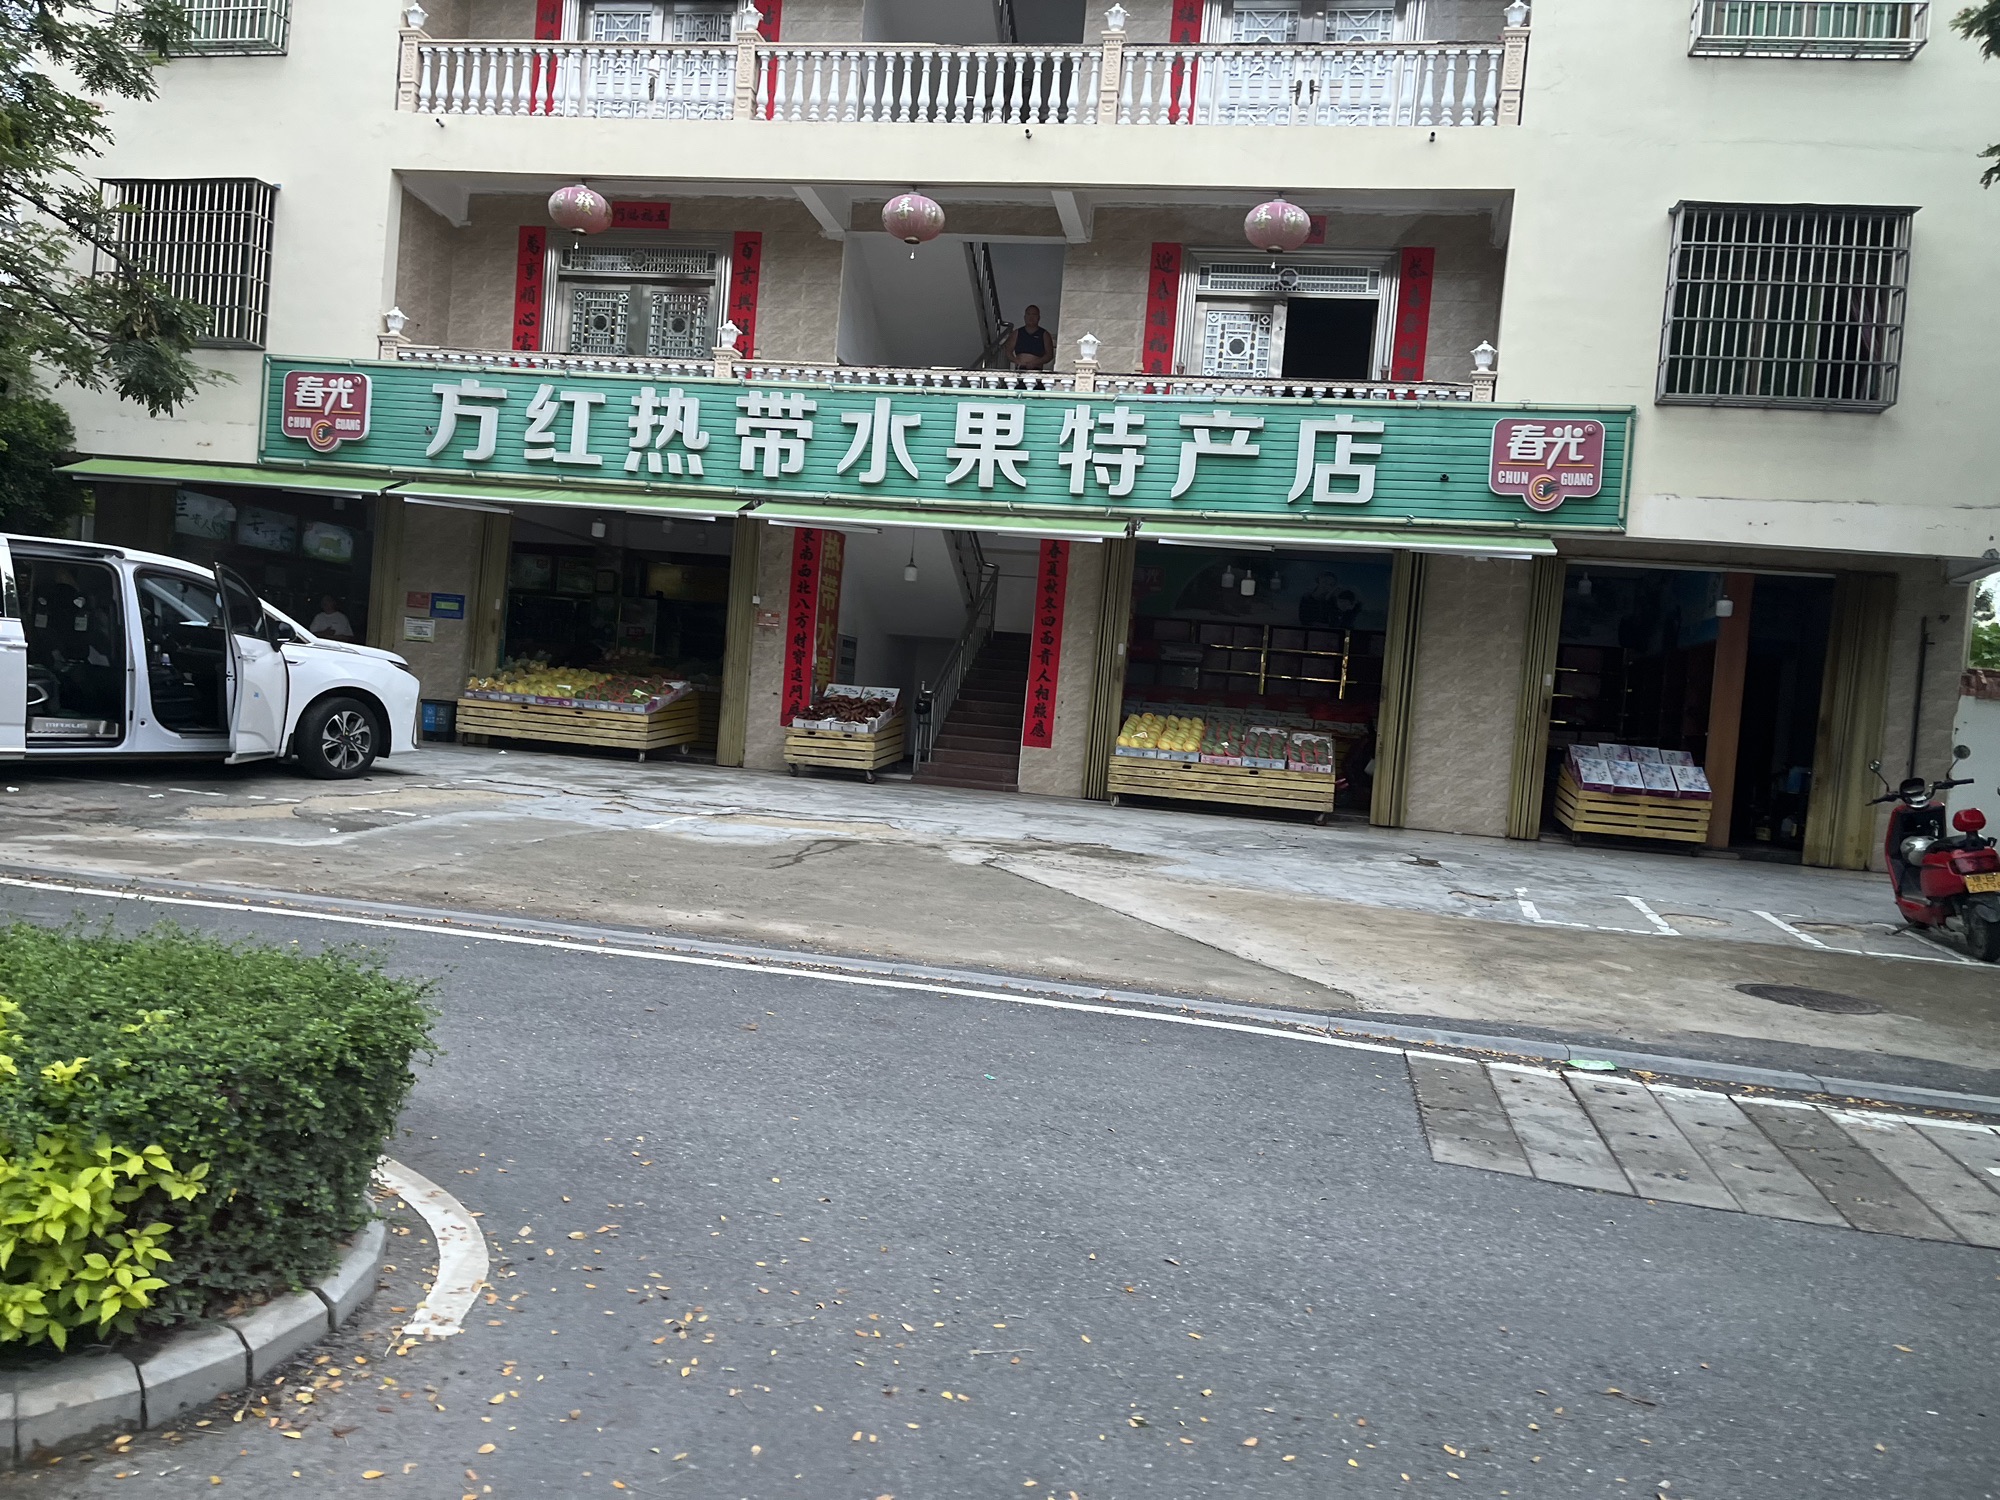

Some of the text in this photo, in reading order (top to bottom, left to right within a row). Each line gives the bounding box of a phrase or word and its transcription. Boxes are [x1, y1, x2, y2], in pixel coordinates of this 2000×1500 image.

[294, 375, 354, 416] 春光
[287, 416, 361, 431] CHUN GUANG
[424, 379, 1385, 505] 方红热带水果特产店
[1506, 424, 1586, 470] 春光
[1497, 470, 1594, 486] CHUN GUANG
